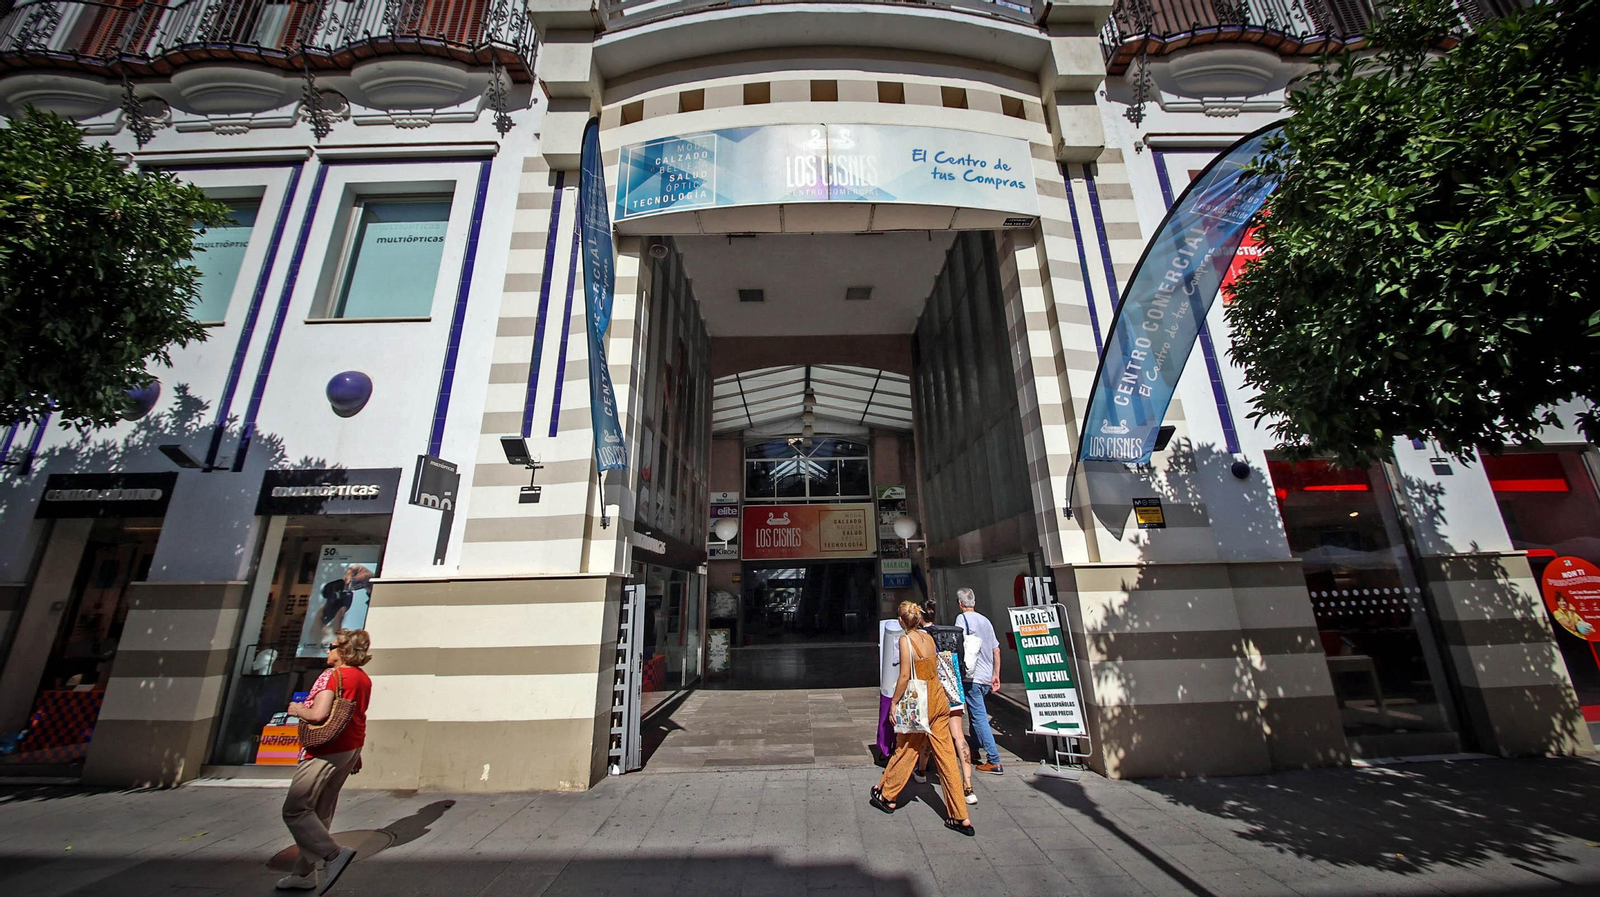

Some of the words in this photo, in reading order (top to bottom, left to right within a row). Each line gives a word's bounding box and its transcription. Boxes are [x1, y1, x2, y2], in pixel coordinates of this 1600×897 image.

[677, 142, 708, 153] MODA
[655, 151, 708, 166] CALZADO
[912, 149, 927, 163] El
[934, 150, 987, 168] Centro
[993, 158, 1012, 172] de
[669, 171, 708, 182] SALUD
[786, 155, 816, 188] LOS
[821, 154, 879, 187] CISNES
[931, 166, 956, 181] tus
[963, 169, 1026, 189] Compras
[633, 190, 708, 209] TECNOLOGÍA
[1114, 337, 1152, 406] CENTRO
[1142, 226, 1210, 332] COMERCIAL
[1146, 342, 1171, 382] Centro
[1164, 325, 1179, 338] de
[1172, 301, 1189, 320] tus
[1182, 247, 1216, 296] Compras
[1089, 436, 1105, 458] LOS
[1106, 437, 1143, 459] CISNES
[717, 507, 737, 515] elite
[755, 528, 772, 548] LOS
[773, 527, 801, 547] CISNES
[1015, 611, 1055, 625] MARIEN
[1021, 635, 1059, 649] CALZADO
[1025, 652, 1064, 666] INFANTIL
[1027, 672, 1035, 683] Y
[1035, 670, 1070, 683] JUVENIL
